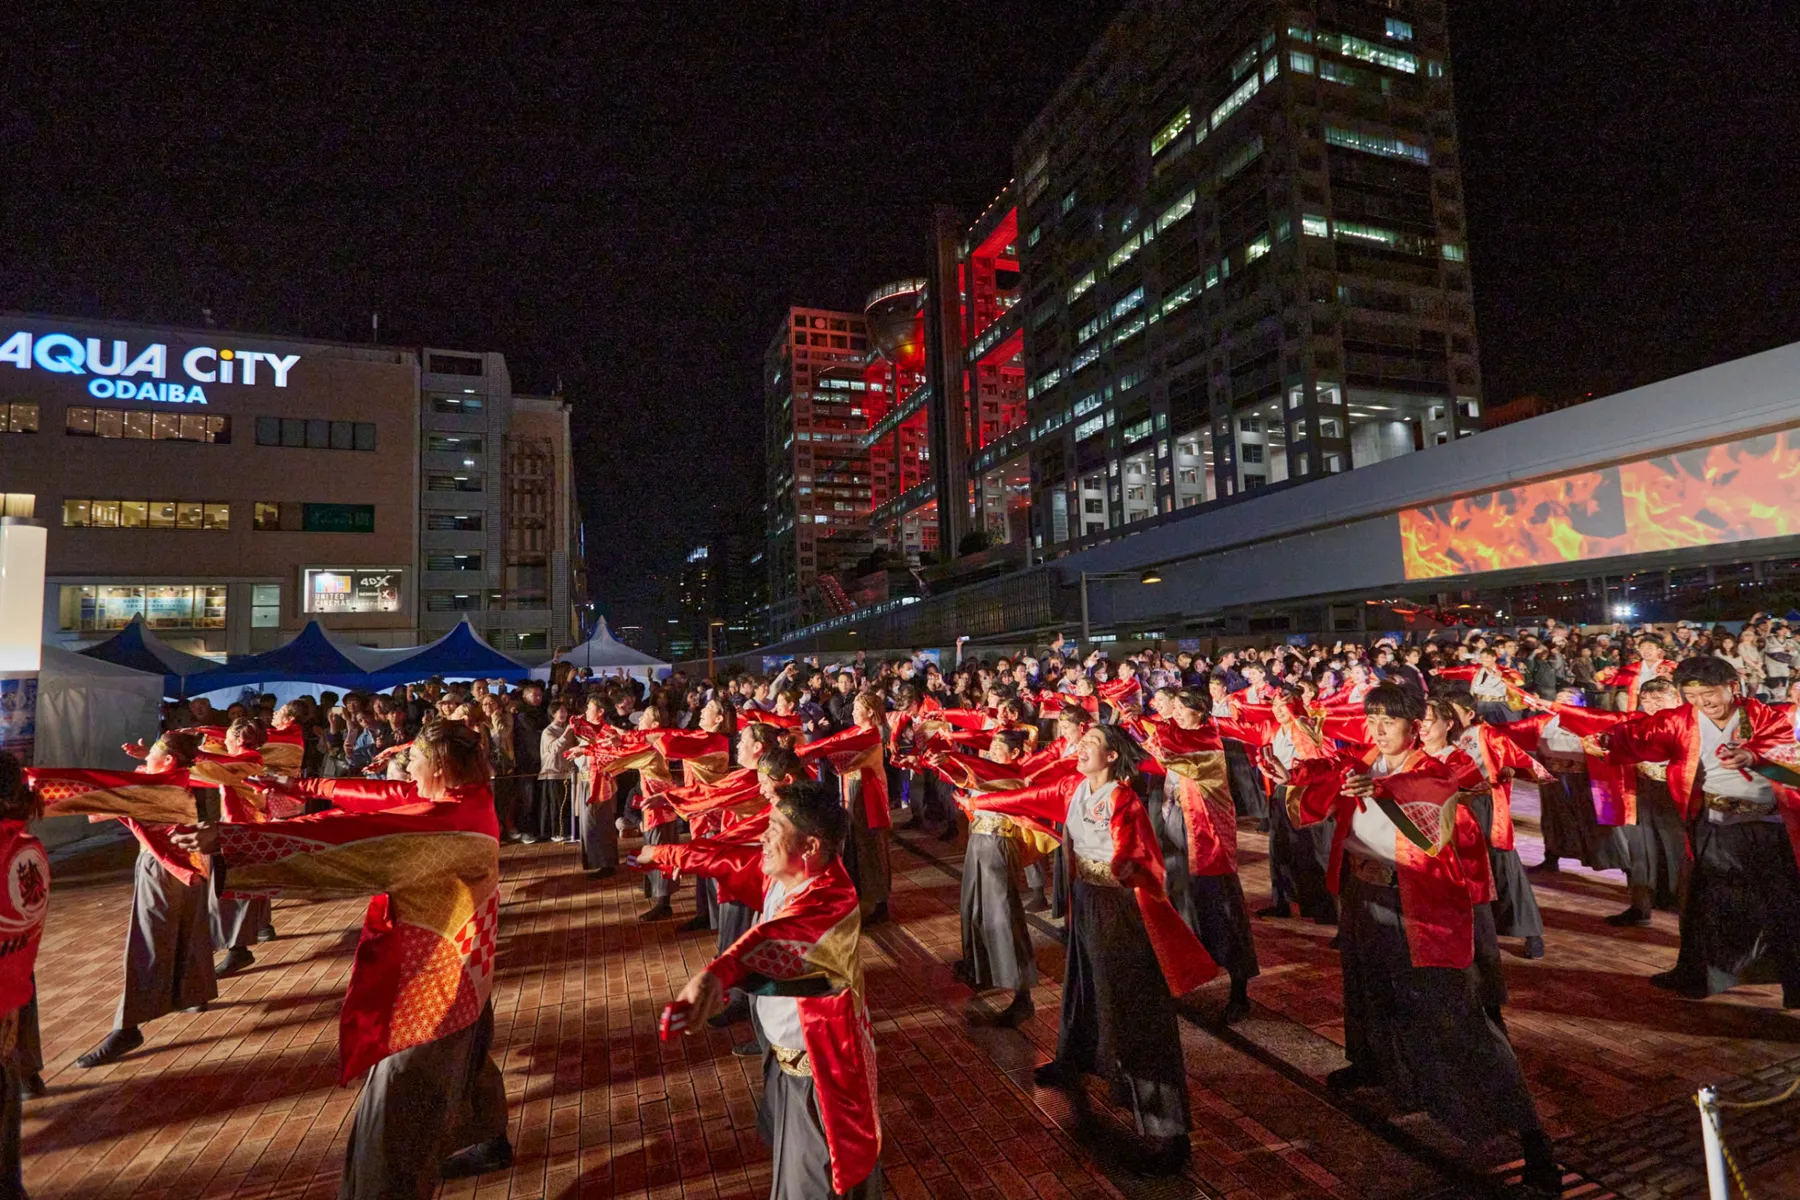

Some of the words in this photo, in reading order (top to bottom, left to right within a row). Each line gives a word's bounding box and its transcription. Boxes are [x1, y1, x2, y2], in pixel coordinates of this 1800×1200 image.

[0, 331, 167, 379] AQUA
[88, 378, 208, 404] ODAIBA
[360, 575, 391, 587] 4DX
